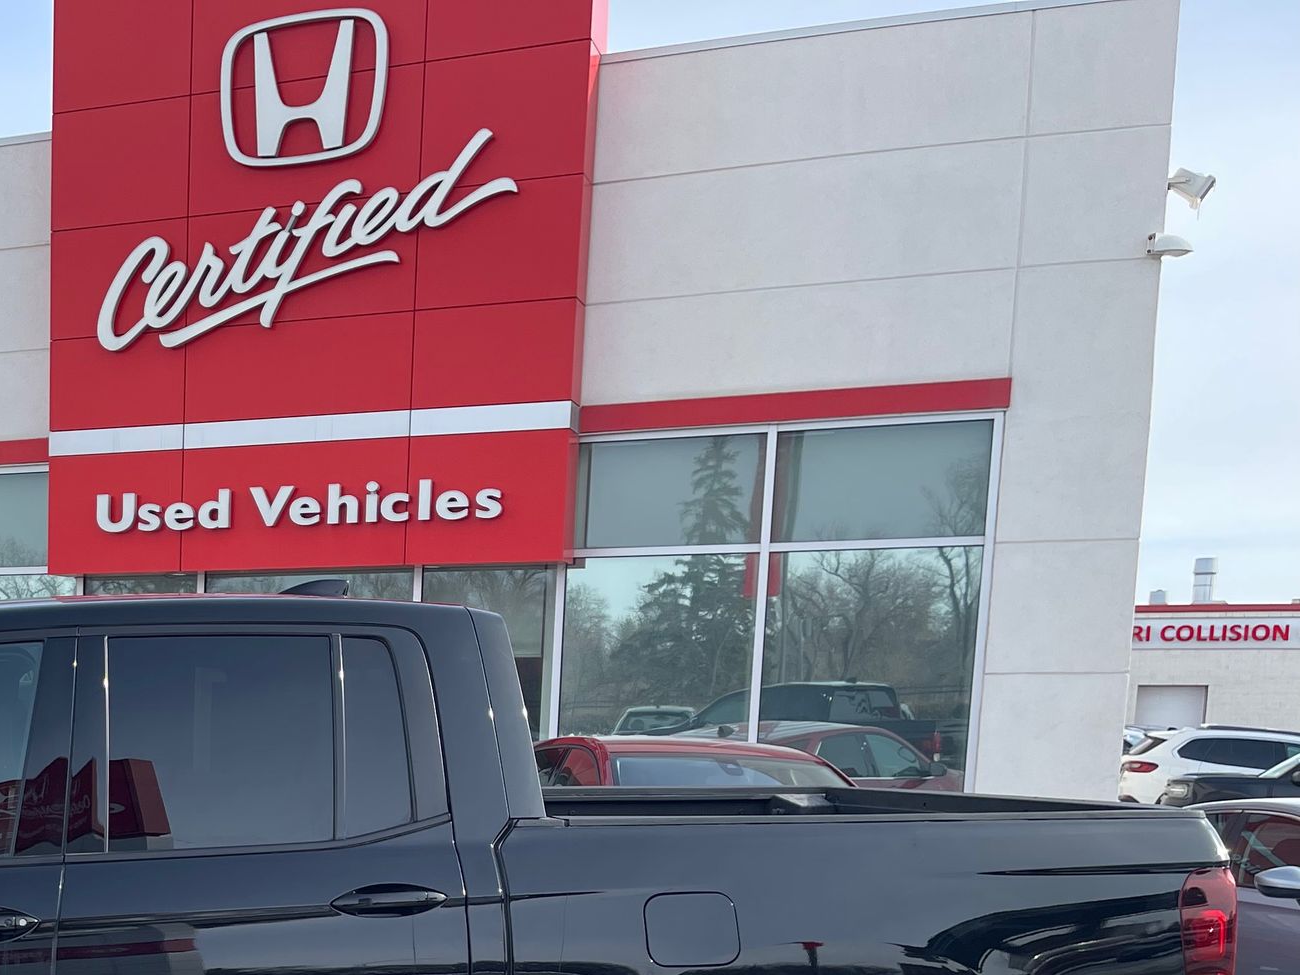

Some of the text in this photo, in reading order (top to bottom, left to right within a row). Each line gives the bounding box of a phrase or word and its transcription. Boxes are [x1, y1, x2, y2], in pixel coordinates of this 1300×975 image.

[96, 128, 519, 352] Certified
[96, 479, 503, 534] Used Vehicles
[1160, 624, 1290, 642] COLLISION
